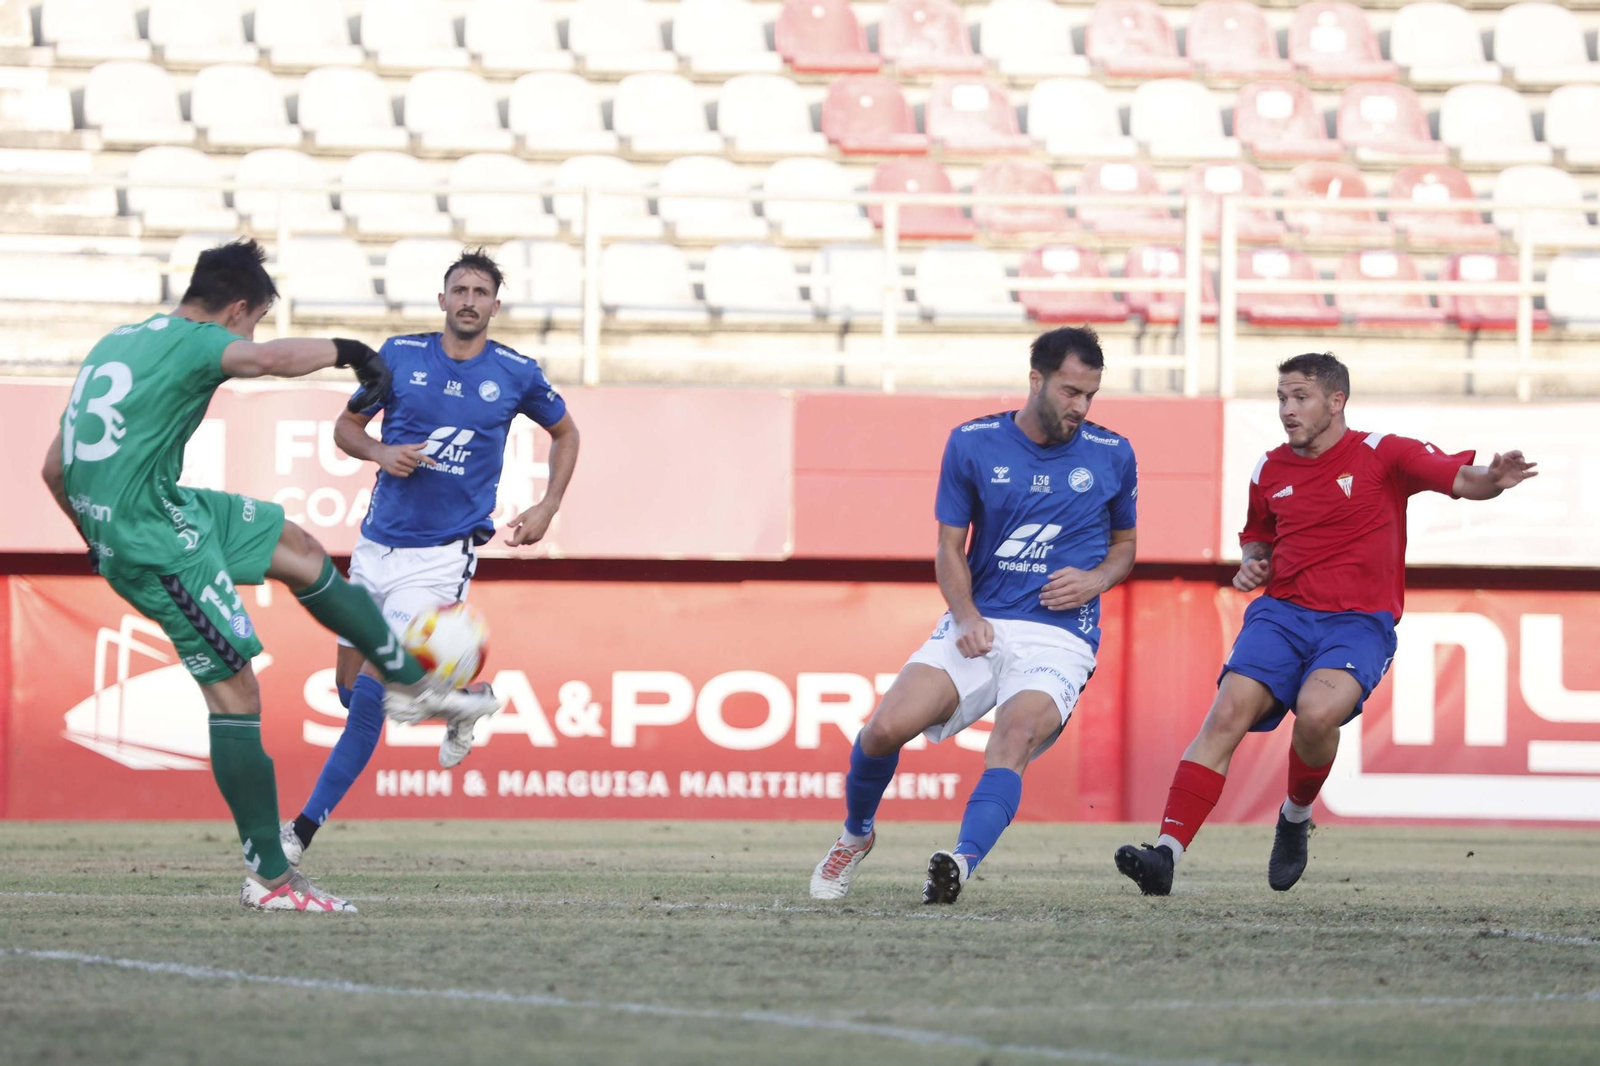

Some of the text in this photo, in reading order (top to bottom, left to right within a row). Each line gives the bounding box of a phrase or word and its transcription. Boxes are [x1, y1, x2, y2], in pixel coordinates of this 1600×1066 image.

[62, 361, 133, 465] 13
[437, 444, 472, 463] Air
[1019, 541, 1054, 559] Air
[998, 560, 1047, 573] oneair.es
[200, 570, 242, 620] 13
[375, 769, 961, 799] HMM & MARGUISA MARITIME ENT
